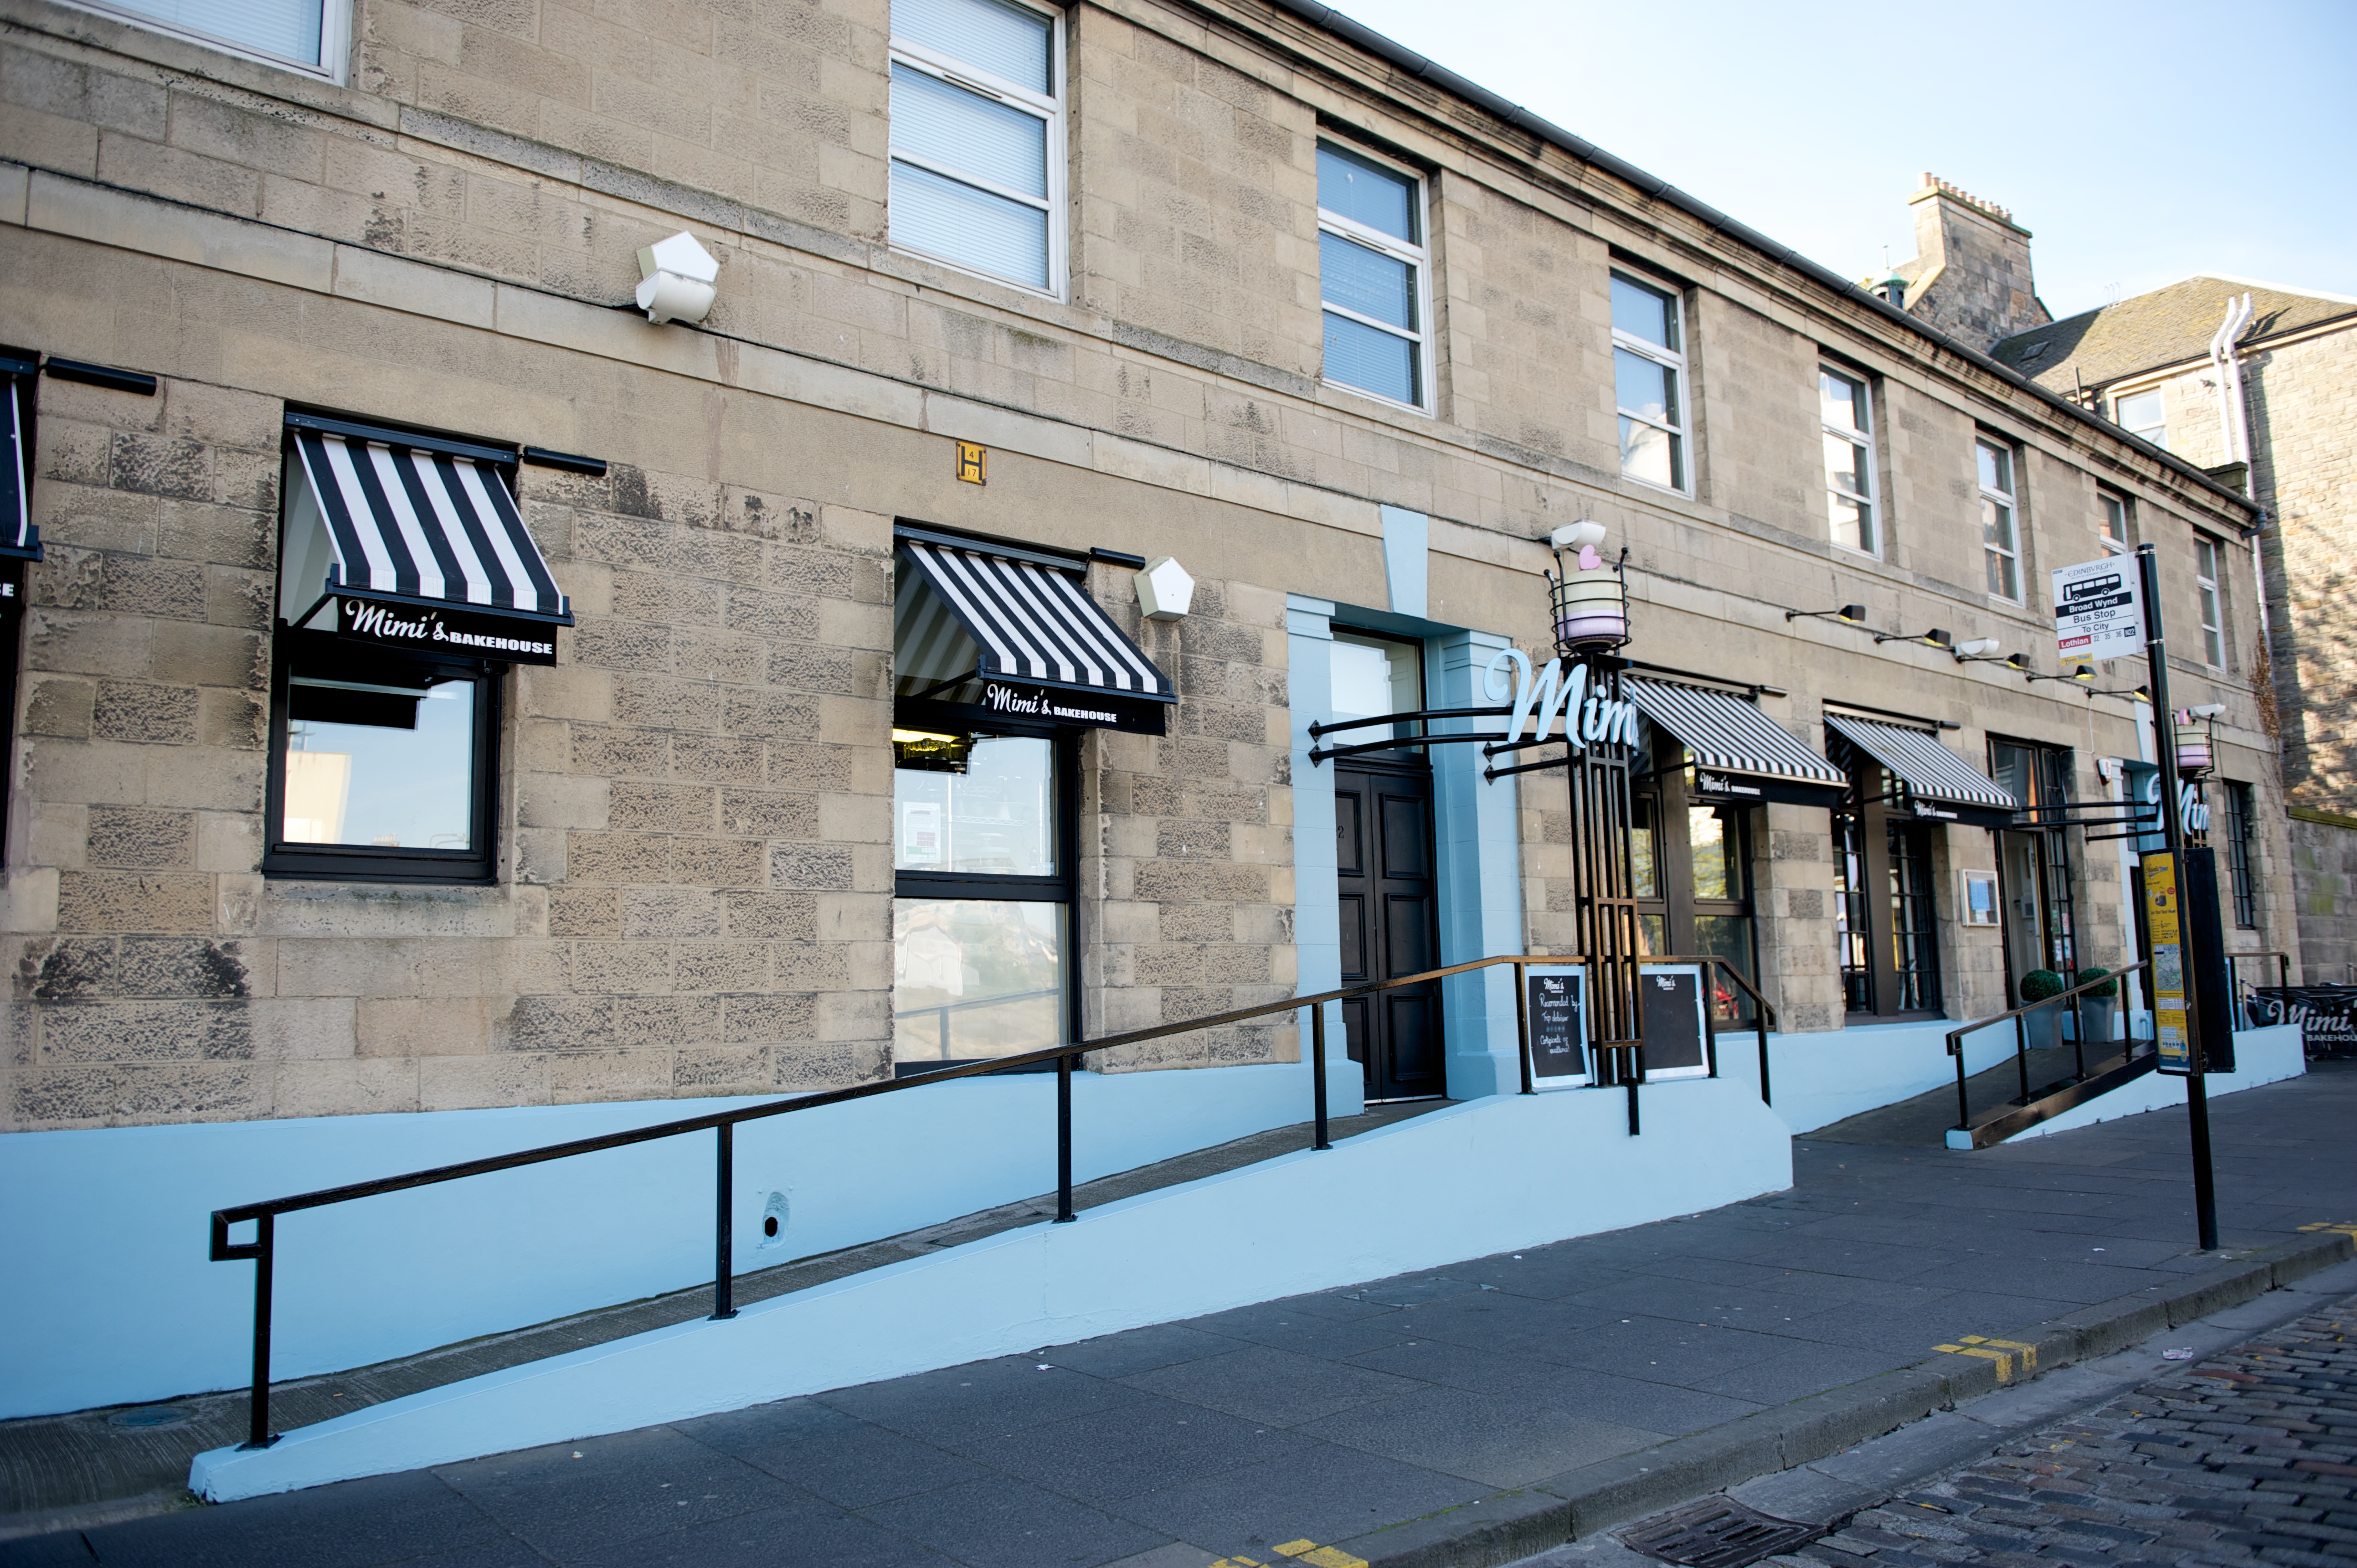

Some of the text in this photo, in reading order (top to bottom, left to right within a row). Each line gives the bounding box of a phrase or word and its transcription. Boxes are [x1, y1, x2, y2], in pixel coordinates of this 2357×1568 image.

[969, 451, 974, 459] 4
[968, 468, 976, 477] 17
[2068, 597, 2118, 613] Broad Wynd
[2073, 610, 2116, 623] Bus Stop
[345, 599, 553, 654] Mimi's BAKEHOUSE
[2093, 623, 2109, 631] City
[2061, 637, 2088, 648] Lothian
[2125, 628, 2135, 636] N22
[987, 683, 1117, 723] Mimi's BAKEHOUSE
[1699, 772, 1731, 792] Mimi's
[1914, 800, 1937, 818] Mimi's
[1543, 977, 1565, 991] Mimi's
[1571, 994, 1578, 1013] by
